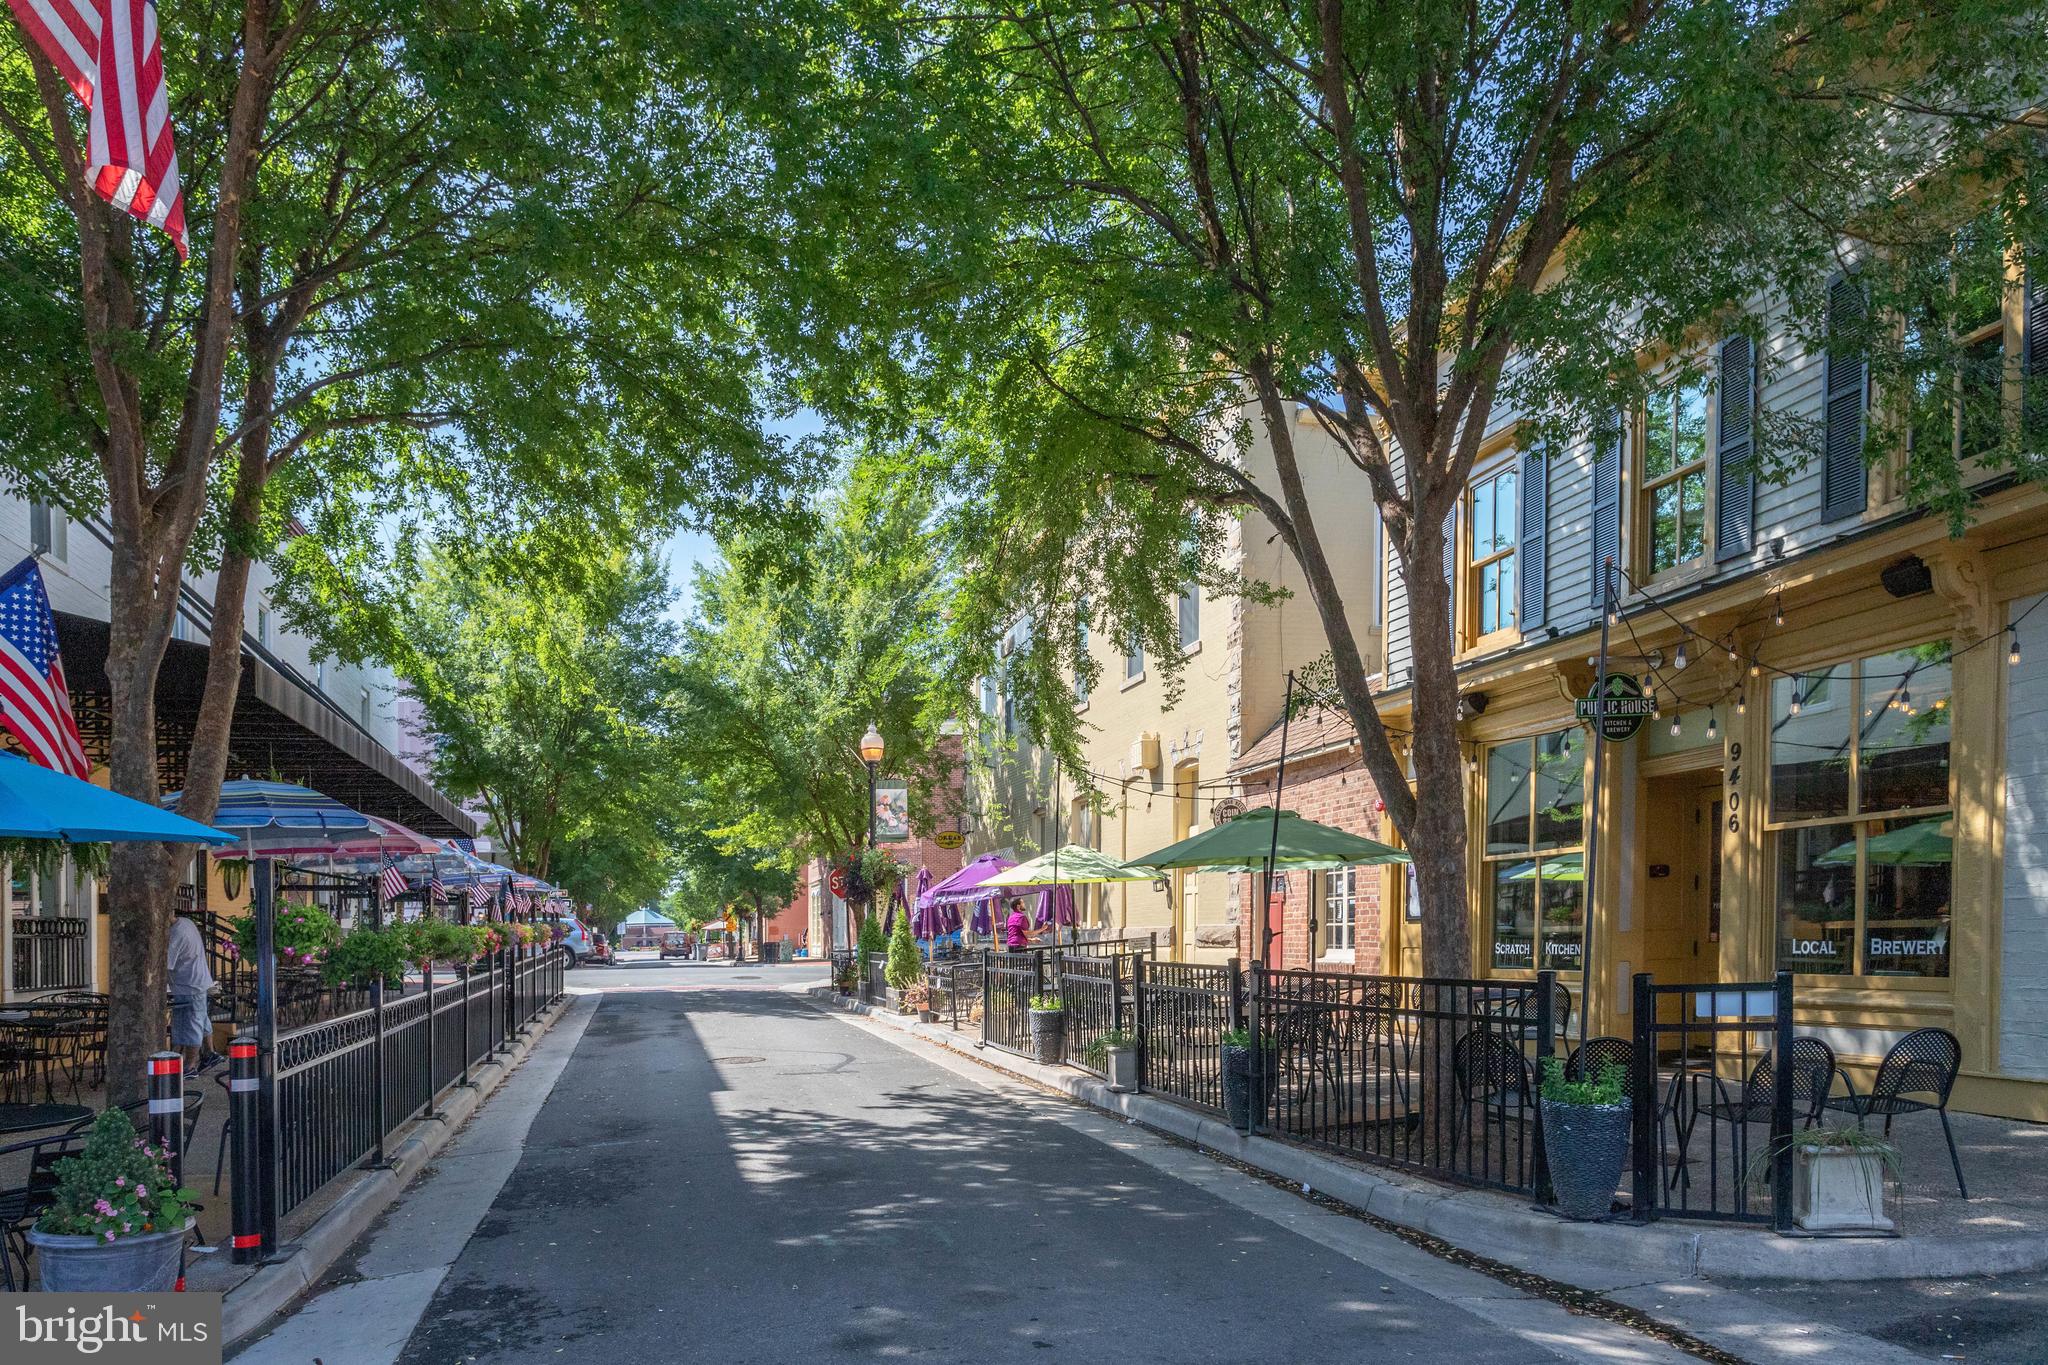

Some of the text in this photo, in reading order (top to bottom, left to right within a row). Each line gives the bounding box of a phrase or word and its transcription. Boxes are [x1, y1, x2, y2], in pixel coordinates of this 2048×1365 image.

[1621, 700, 1655, 714] HOUSE
[1729, 743, 1742, 833] 9406
[1222, 808, 1239, 817] COIN
[832, 876, 845, 890] ST
[1495, 942, 1581, 955] SCRATCH KITCHEN
[1792, 938, 1947, 956] LOCAL BREWERY
